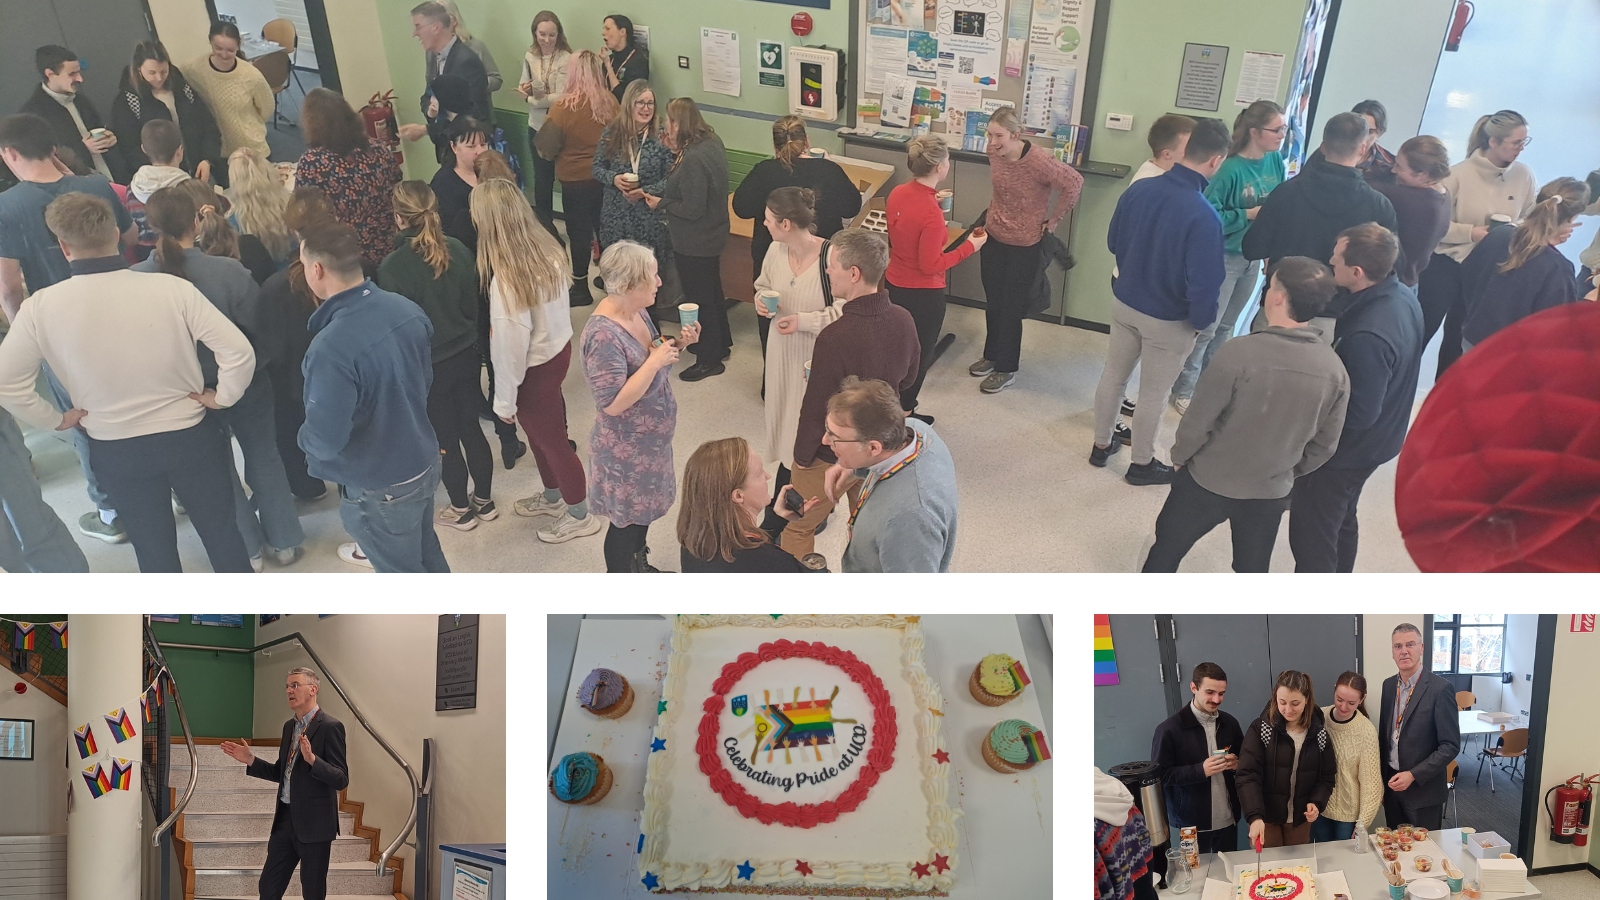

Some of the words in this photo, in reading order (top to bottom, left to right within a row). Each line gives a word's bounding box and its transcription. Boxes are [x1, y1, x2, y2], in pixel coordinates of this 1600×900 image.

[724, 737, 794, 792] Celebrating
[796, 767, 838, 787] Pride
[839, 754, 853, 770] at
[847, 723, 867, 756] UCD
